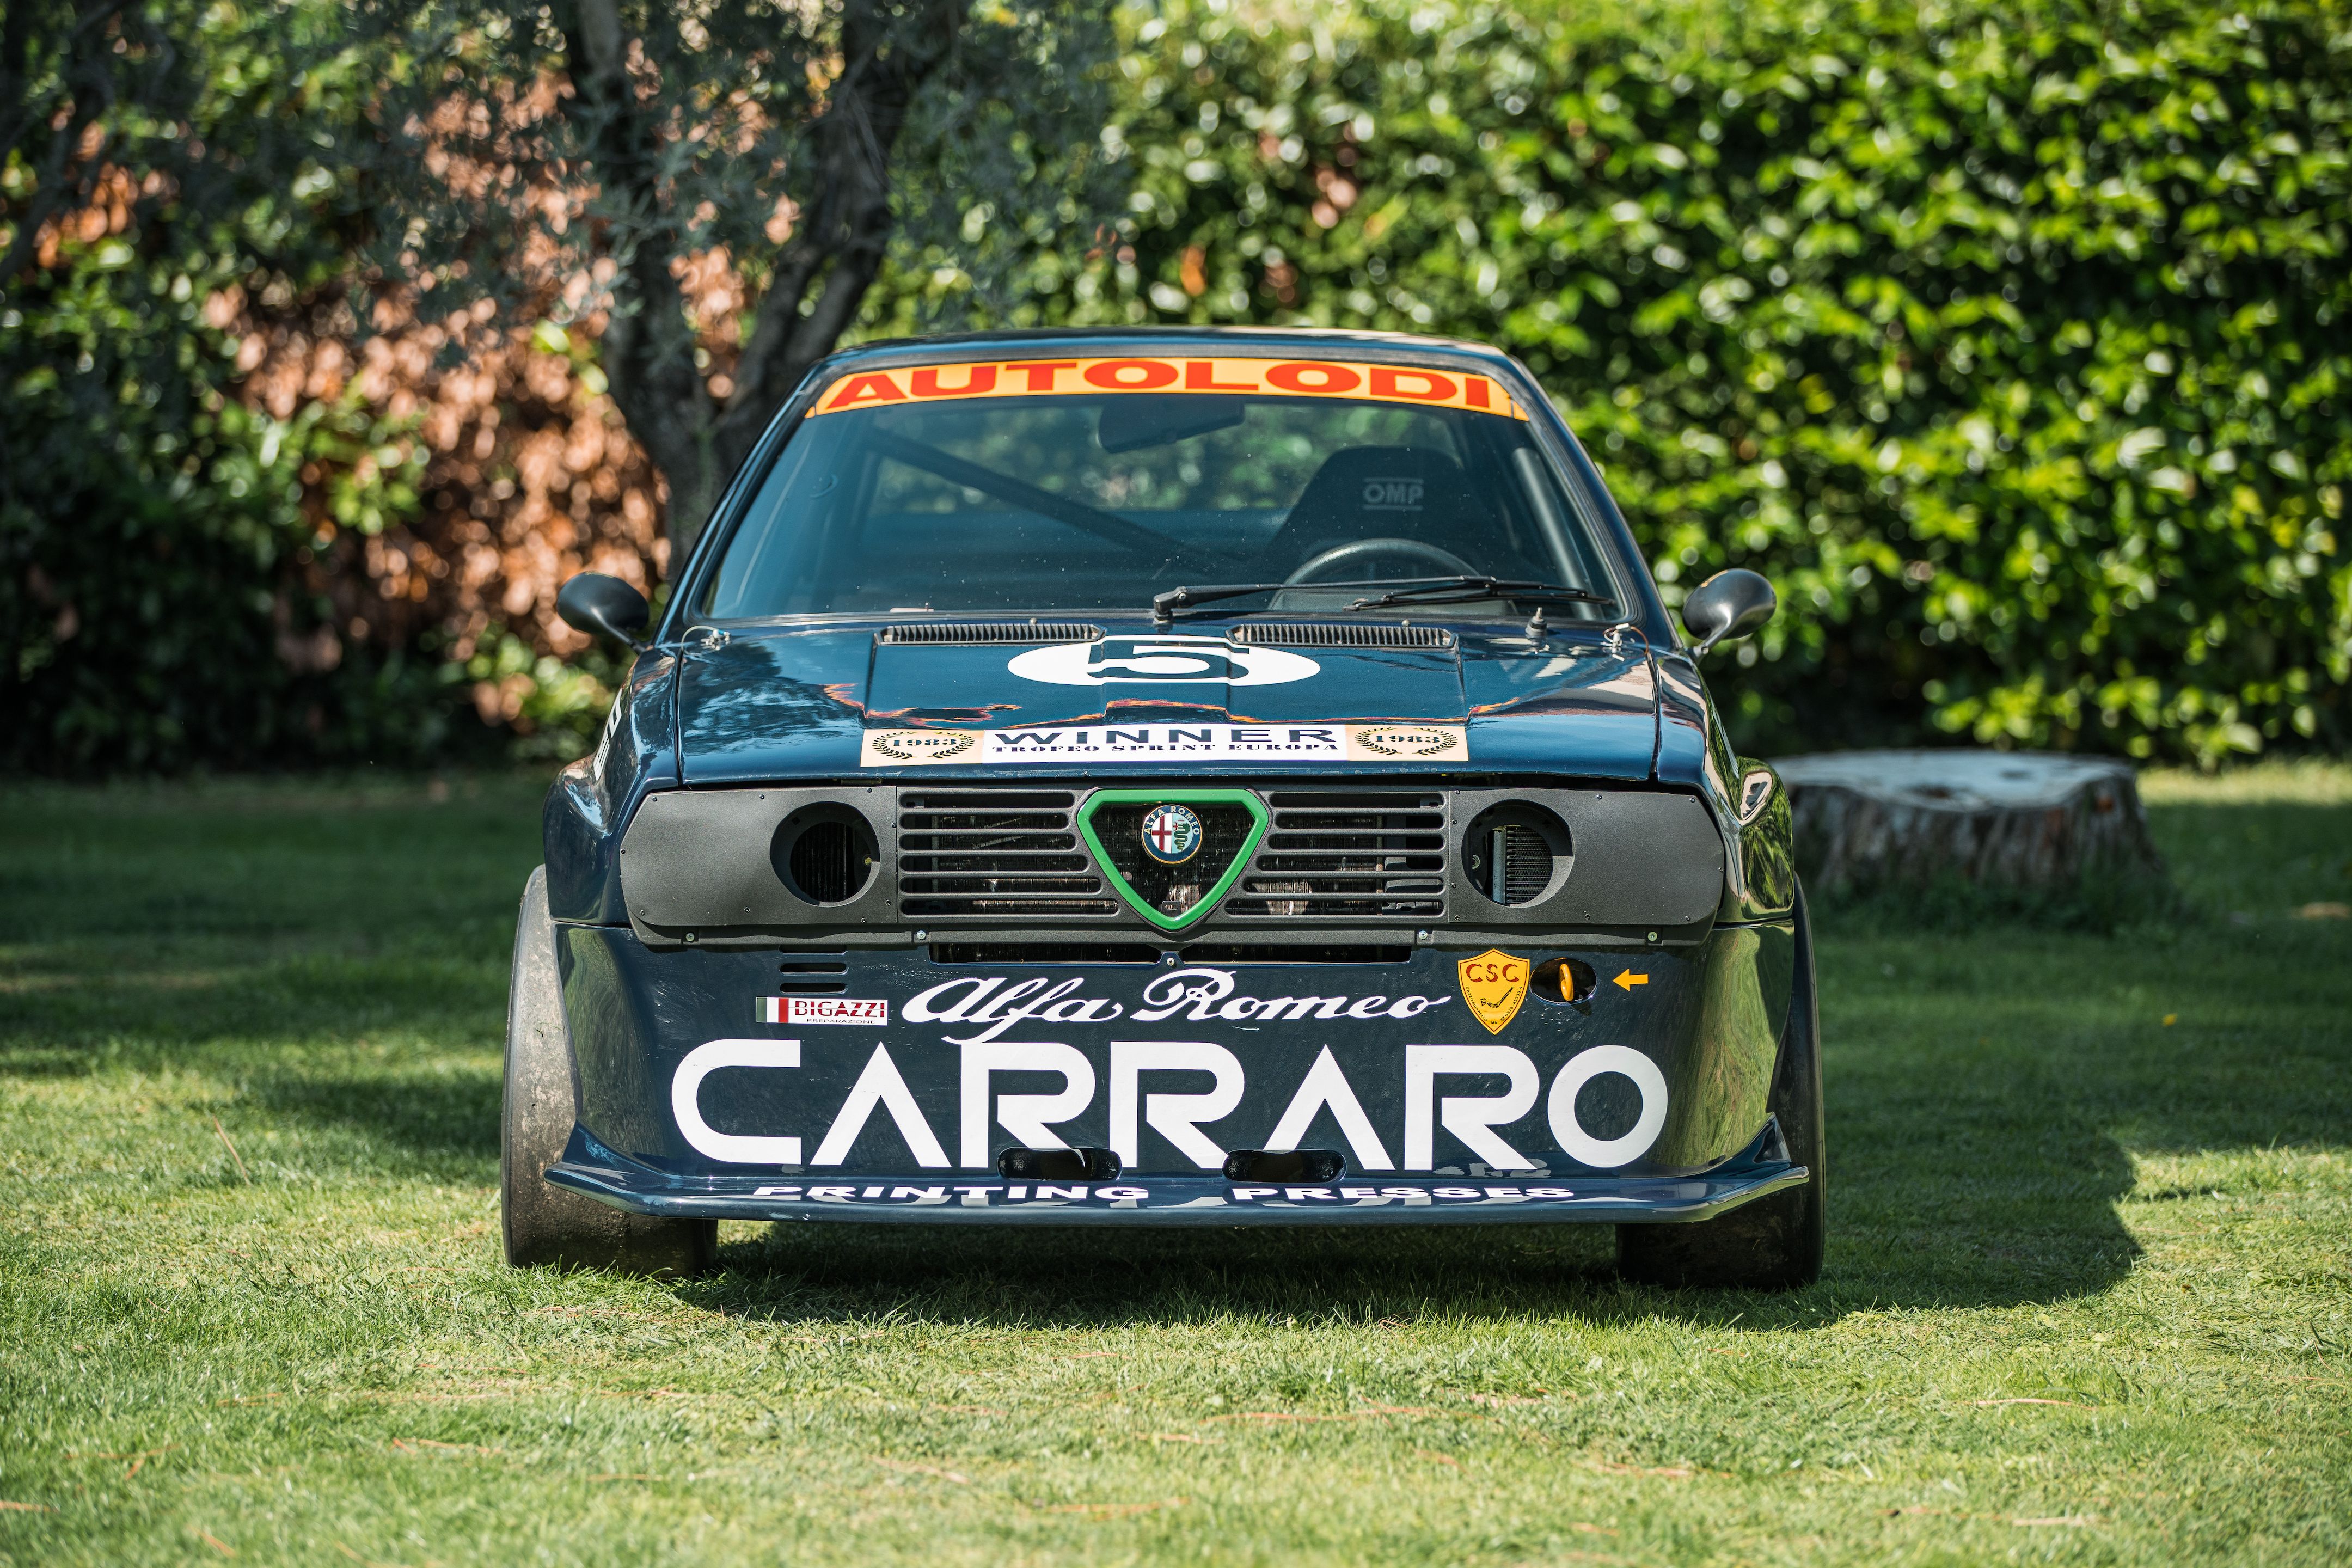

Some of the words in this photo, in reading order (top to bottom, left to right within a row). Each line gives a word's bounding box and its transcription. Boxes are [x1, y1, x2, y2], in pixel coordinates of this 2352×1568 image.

[826, 360, 1489, 409] AUTOLODI
[1363, 483, 1424, 503] OMP
[1087, 640, 1249, 679] 5
[892, 738, 957, 746] 1983
[994, 729, 1337, 744] WINNER
[1375, 735, 1441, 744] 1983
[1144, 808, 1165, 834] ALFA
[1171, 806, 1200, 835] ROMEO
[1466, 964, 1519, 982] CSC
[795, 1001, 885, 1017] BIGAZZI
[902, 977, 1123, 1045] Alfa
[1130, 968, 1451, 1021] Romeo
[671, 1038, 1669, 1171] CARRARO
[752, 1186, 1149, 1199] PRINTING
[1232, 1187, 1575, 1199] PRESSES
